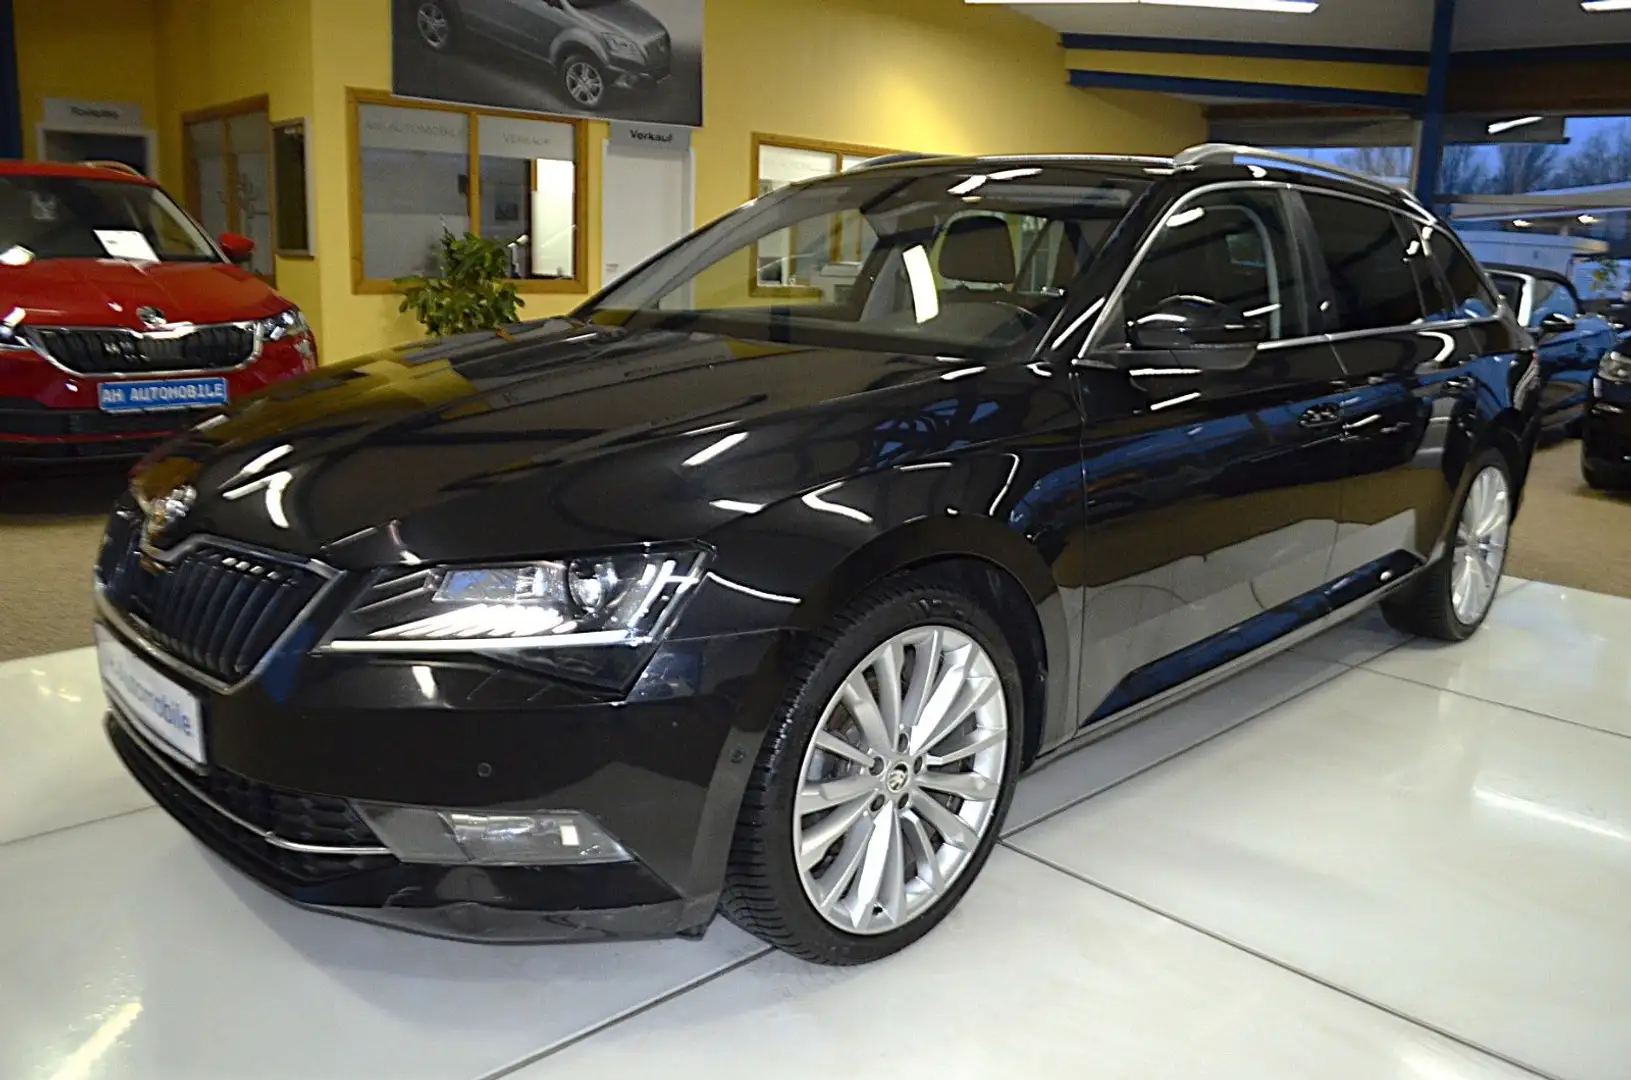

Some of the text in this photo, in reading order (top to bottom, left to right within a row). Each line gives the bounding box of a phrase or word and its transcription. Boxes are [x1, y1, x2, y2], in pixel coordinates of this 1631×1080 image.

[629, 130, 674, 146] Verkauf
[102, 383, 223, 403] AH AUTOMOBILE
